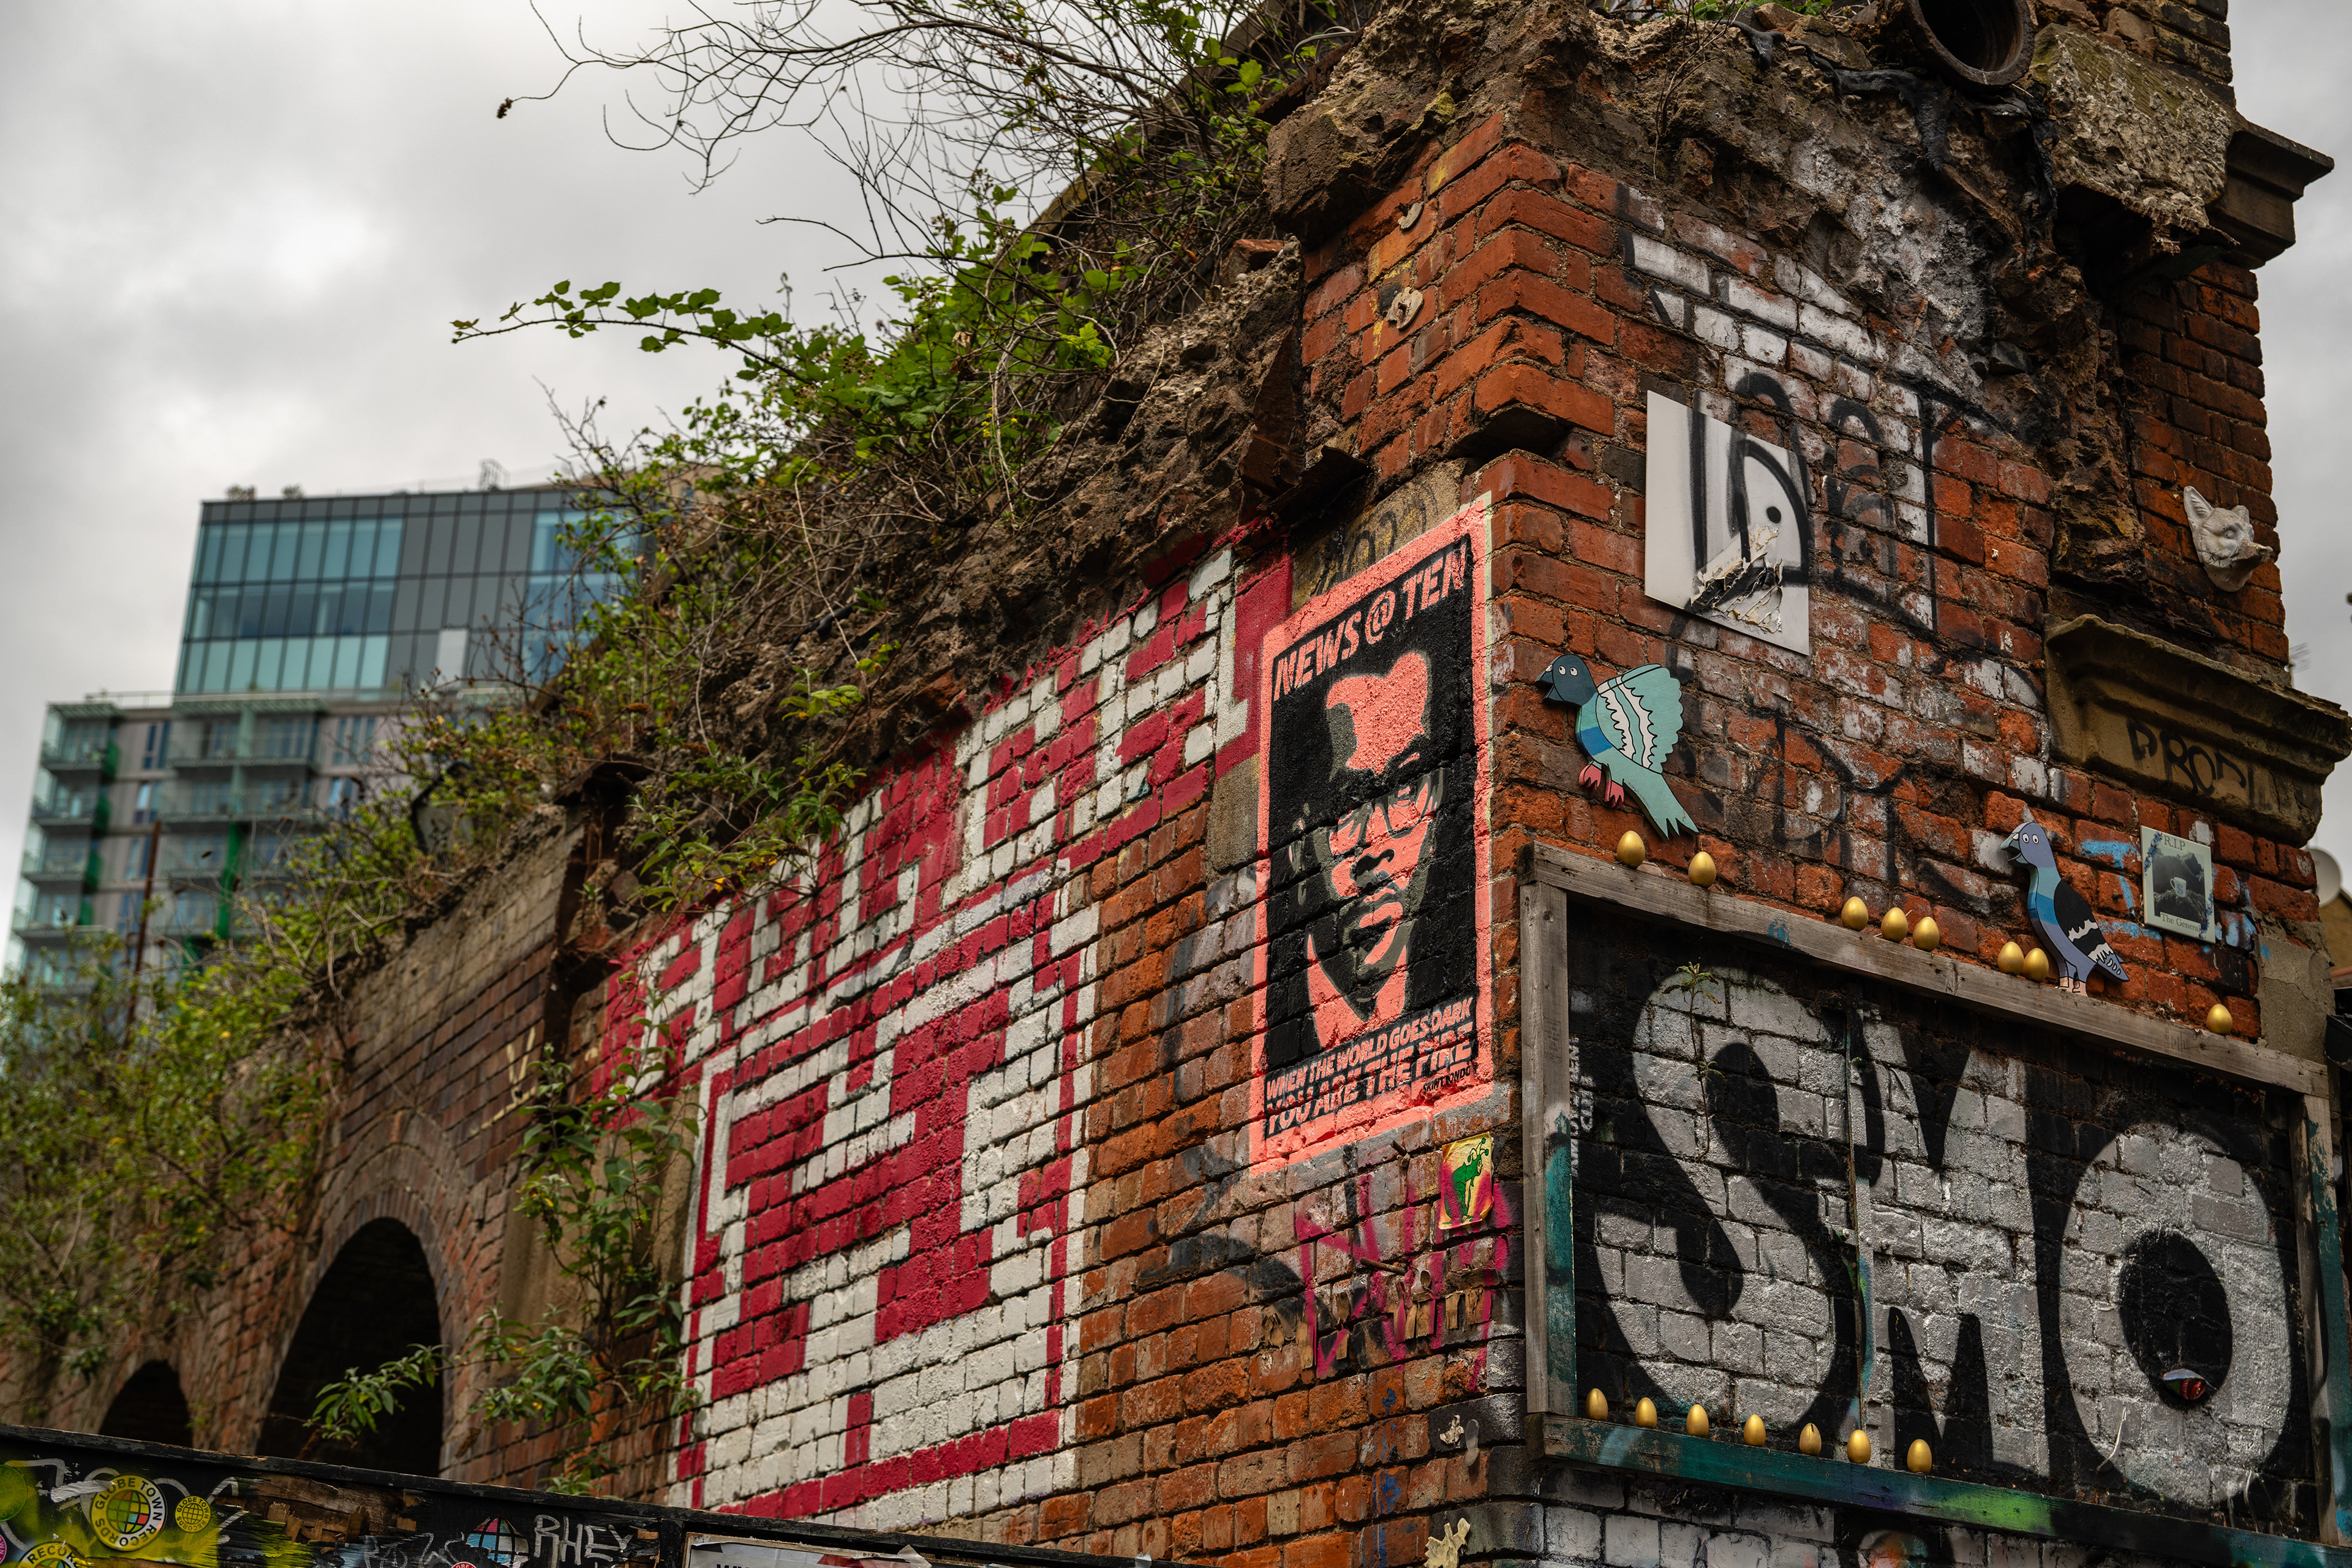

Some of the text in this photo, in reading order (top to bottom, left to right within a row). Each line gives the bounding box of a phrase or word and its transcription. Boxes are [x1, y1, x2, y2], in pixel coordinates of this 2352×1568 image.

[1273, 611, 1362, 701] NEWS
[1403, 542, 1467, 620] TEN
[2163, 835, 2186, 851] R.I.P
[2161, 913, 2201, 932] The General
[1267, 997, 1474, 1100] WHEN THE WORLD GOES DARK
[95, 1477, 163, 1547] GLOBE TOWN RECORDS
[176, 1497, 209, 1531] GLOBE TOWN RECORDS
